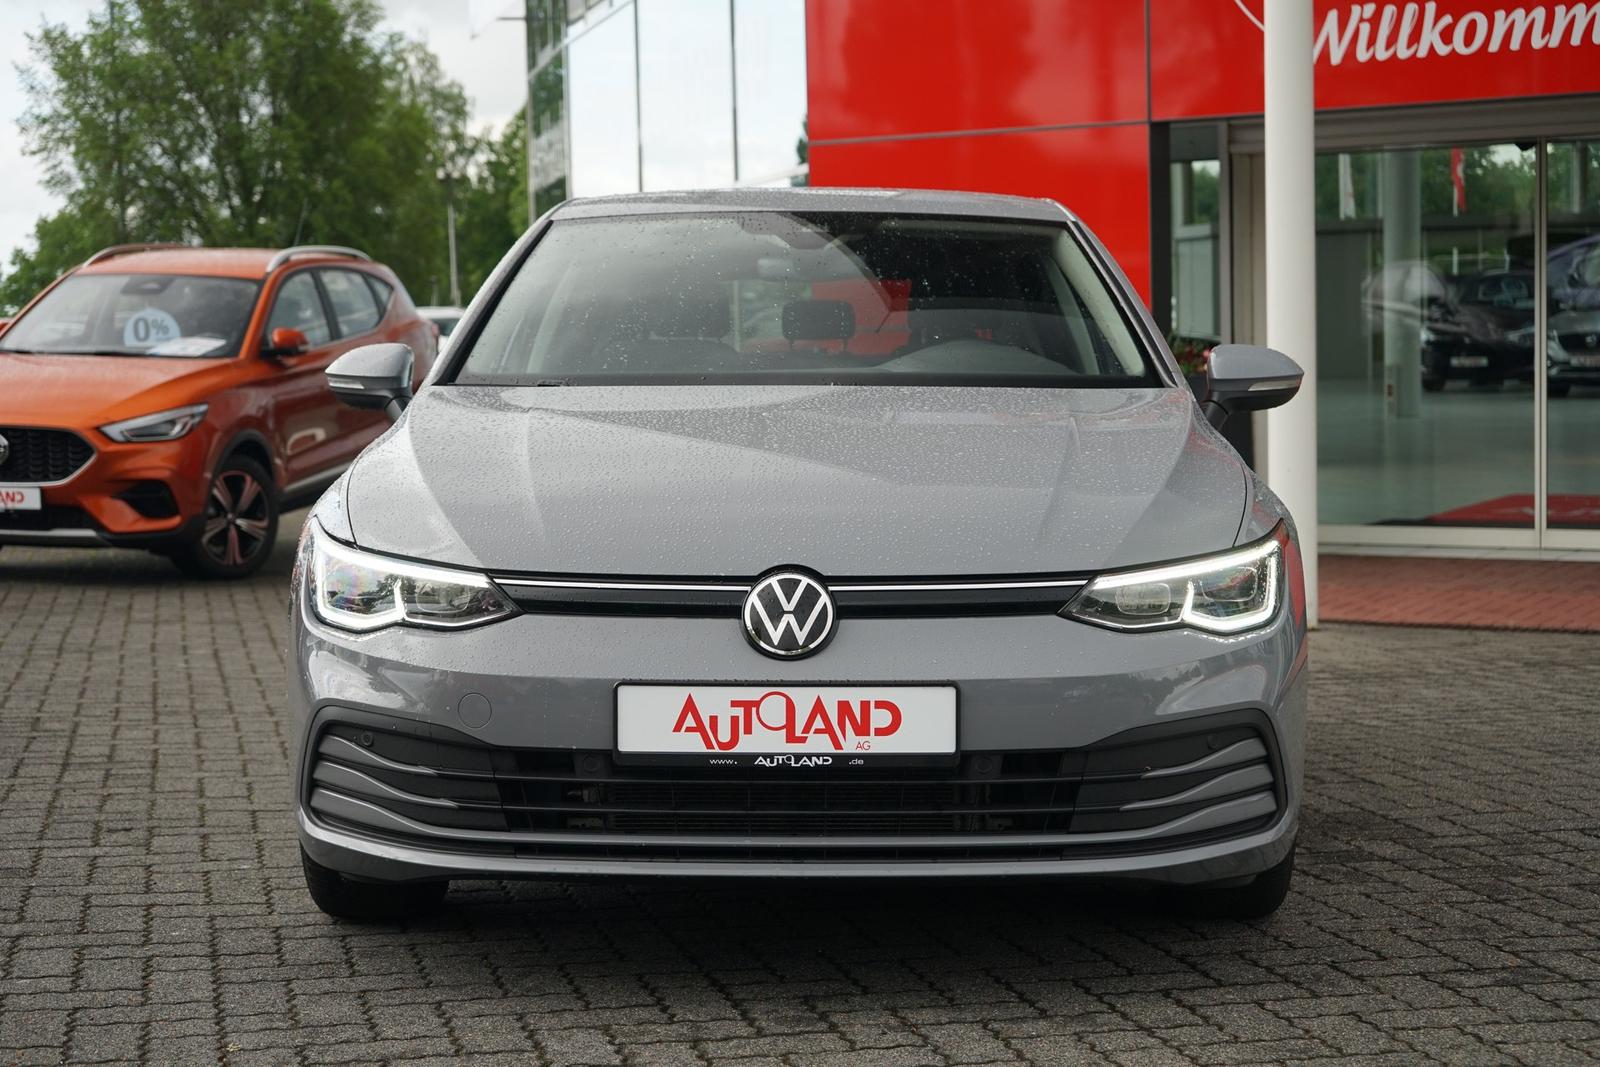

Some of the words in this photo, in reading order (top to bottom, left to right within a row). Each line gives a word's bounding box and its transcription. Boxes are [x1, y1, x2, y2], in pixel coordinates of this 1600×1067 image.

[133, 317, 170, 343] 0%
[748, 576, 830, 648] VW
[855, 741, 871, 751] AG
